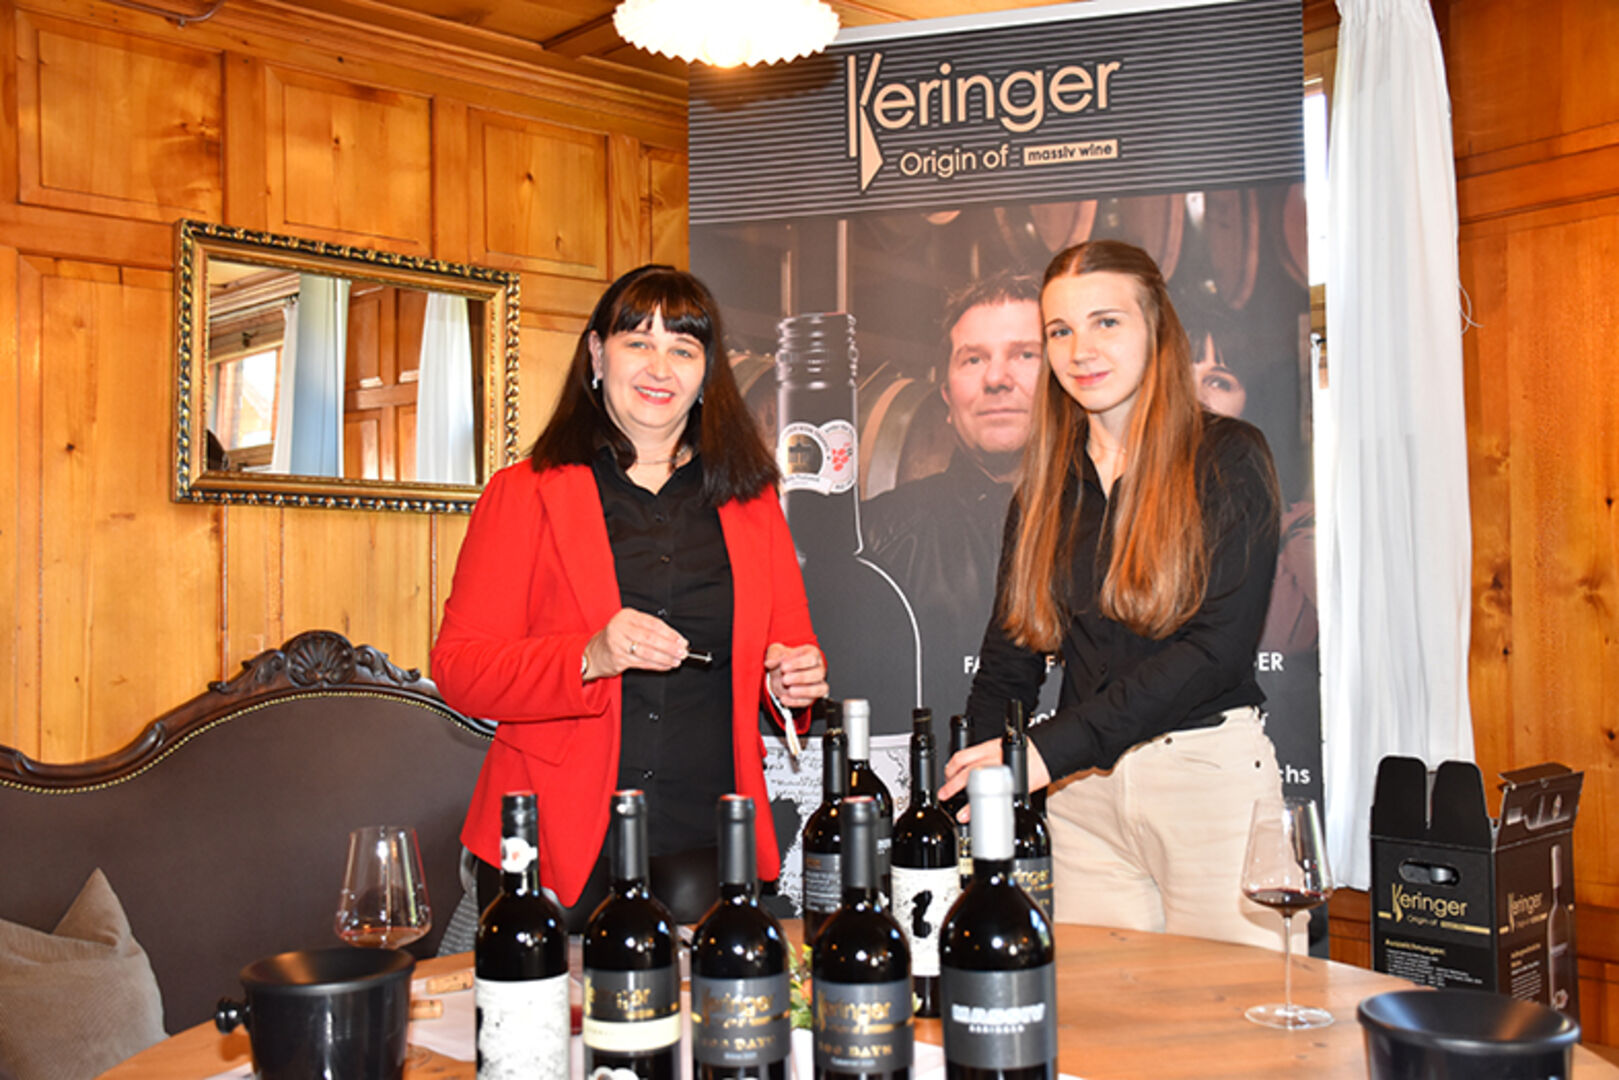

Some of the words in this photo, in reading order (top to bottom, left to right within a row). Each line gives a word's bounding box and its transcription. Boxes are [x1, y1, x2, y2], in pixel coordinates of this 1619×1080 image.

[847, 52, 1121, 192] Keringer
[900, 147, 977, 178] Origin
[983, 143, 1009, 167] of
[1027, 147, 1076, 162] massiv
[1080, 142, 1113, 158] wine
[1391, 883, 1468, 923] Keringer
